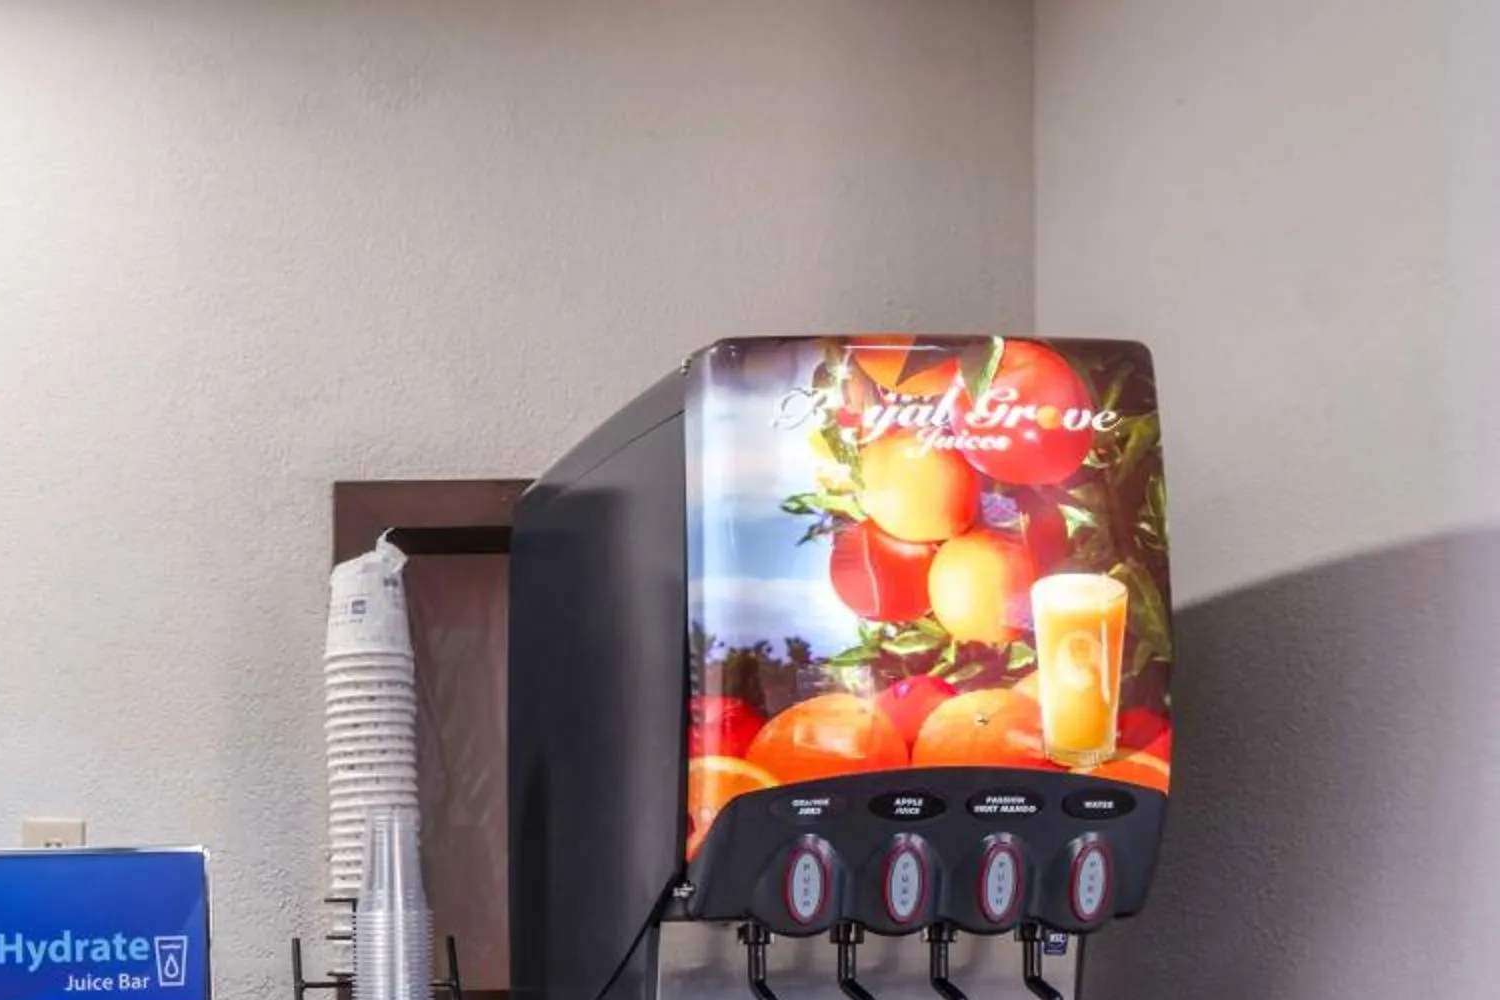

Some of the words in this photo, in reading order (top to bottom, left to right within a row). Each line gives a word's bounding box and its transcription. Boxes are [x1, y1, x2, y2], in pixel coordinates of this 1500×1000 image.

[965, 386, 1124, 431] Grove
[893, 798, 924, 807] APPLE
[65, 974, 113, 991] Juice
[118, 973, 150, 990] Bar
